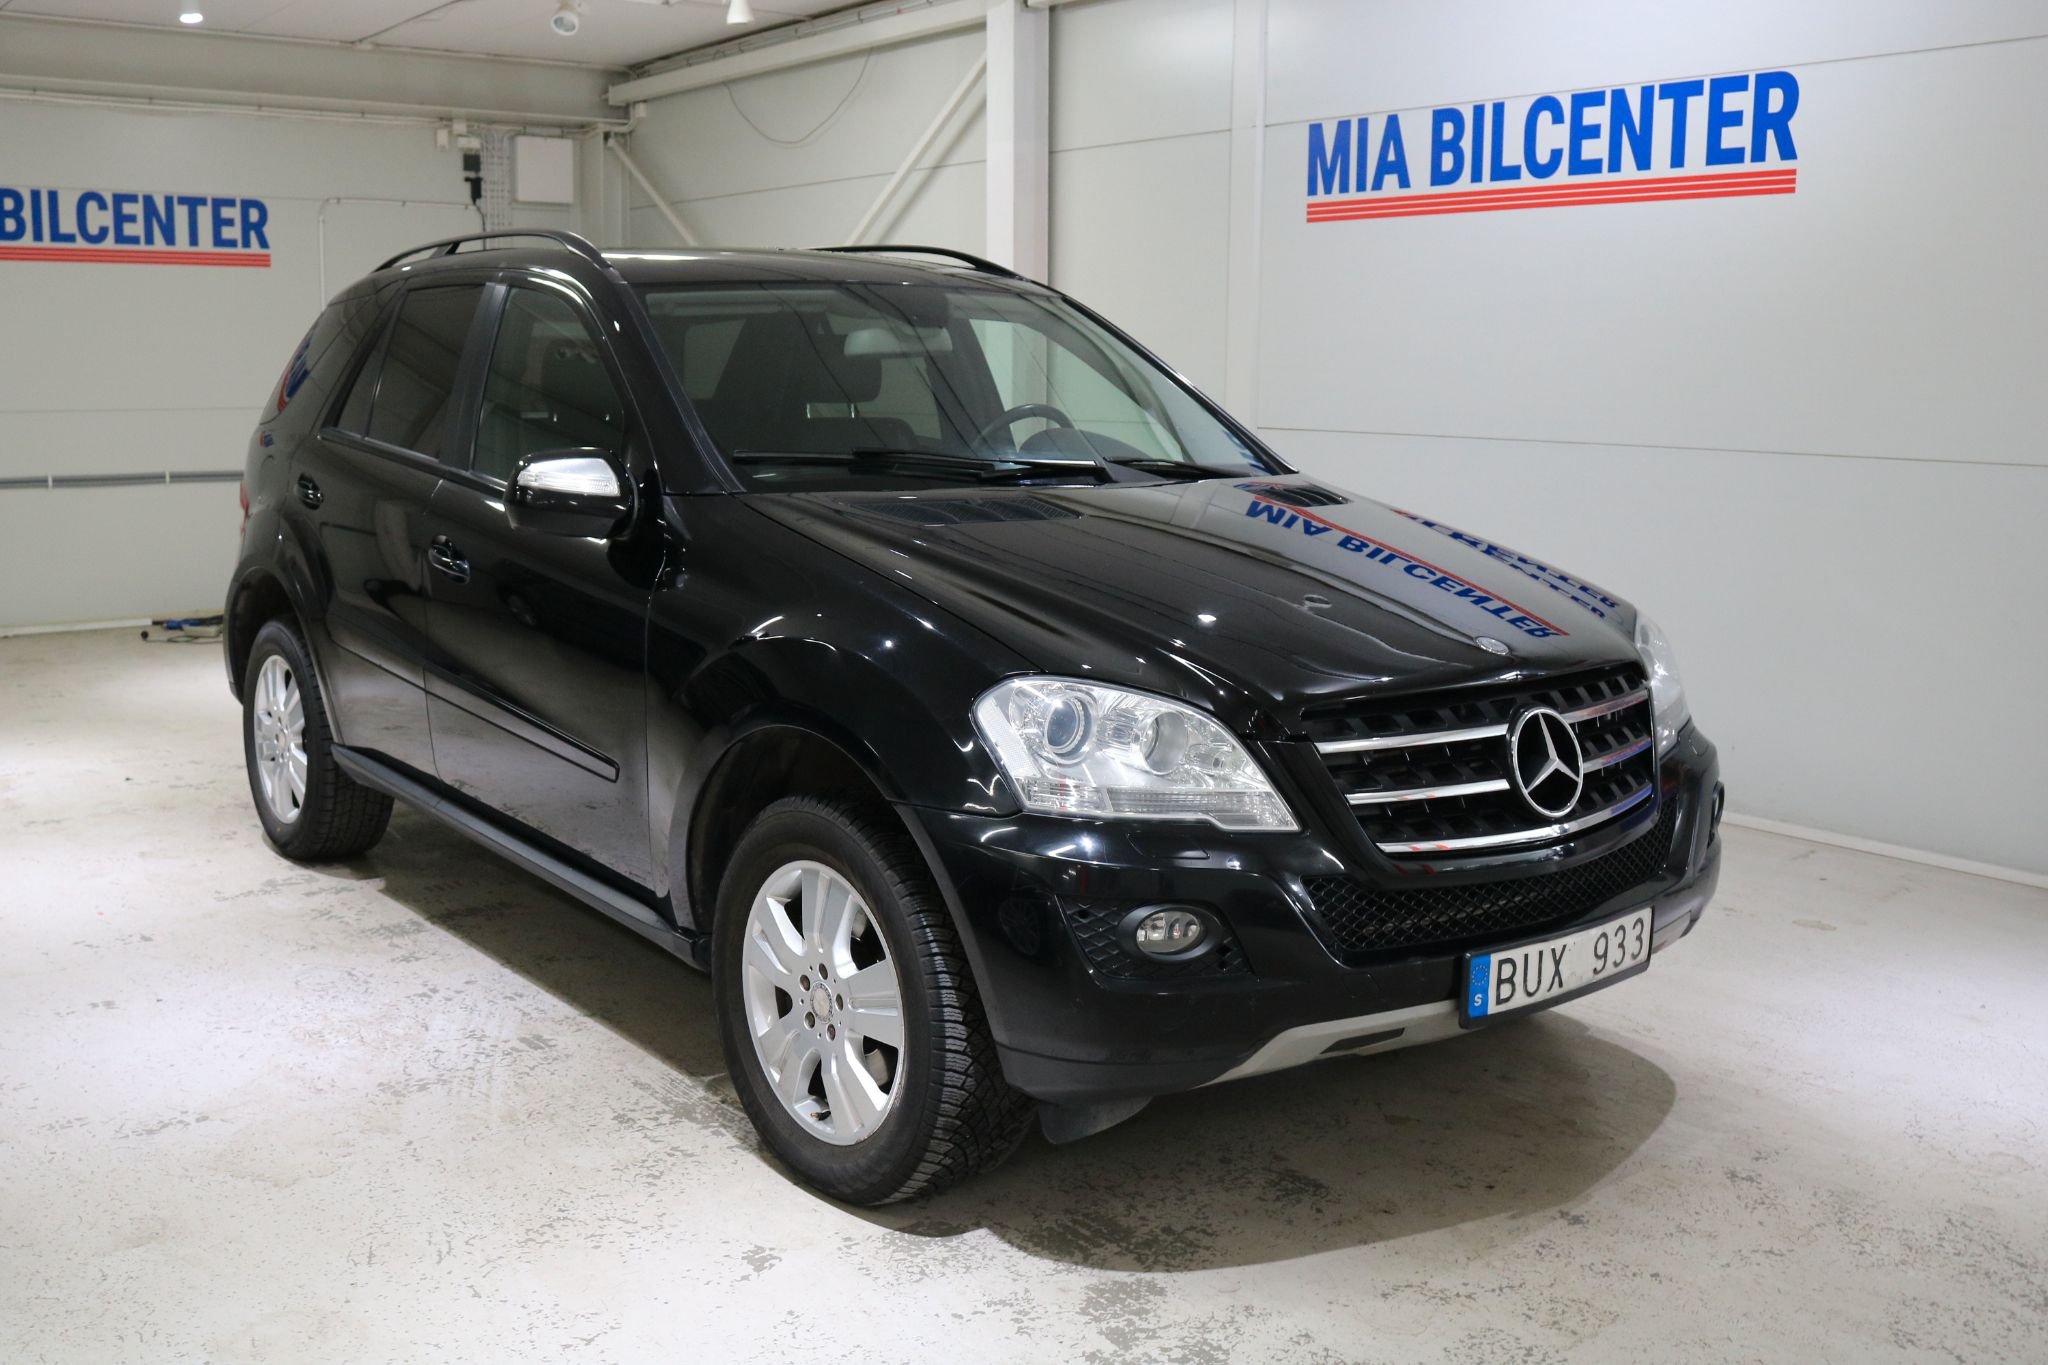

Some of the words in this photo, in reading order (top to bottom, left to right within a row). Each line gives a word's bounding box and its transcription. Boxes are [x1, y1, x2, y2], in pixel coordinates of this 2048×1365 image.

[1307, 114, 1410, 196] MIA
[1430, 71, 1800, 187] BILCENTER
[0, 188, 270, 249] BILCENTER
[1495, 944, 1567, 1006] BUX
[1593, 917, 1644, 975] 933
[1473, 993, 1482, 1007] S
